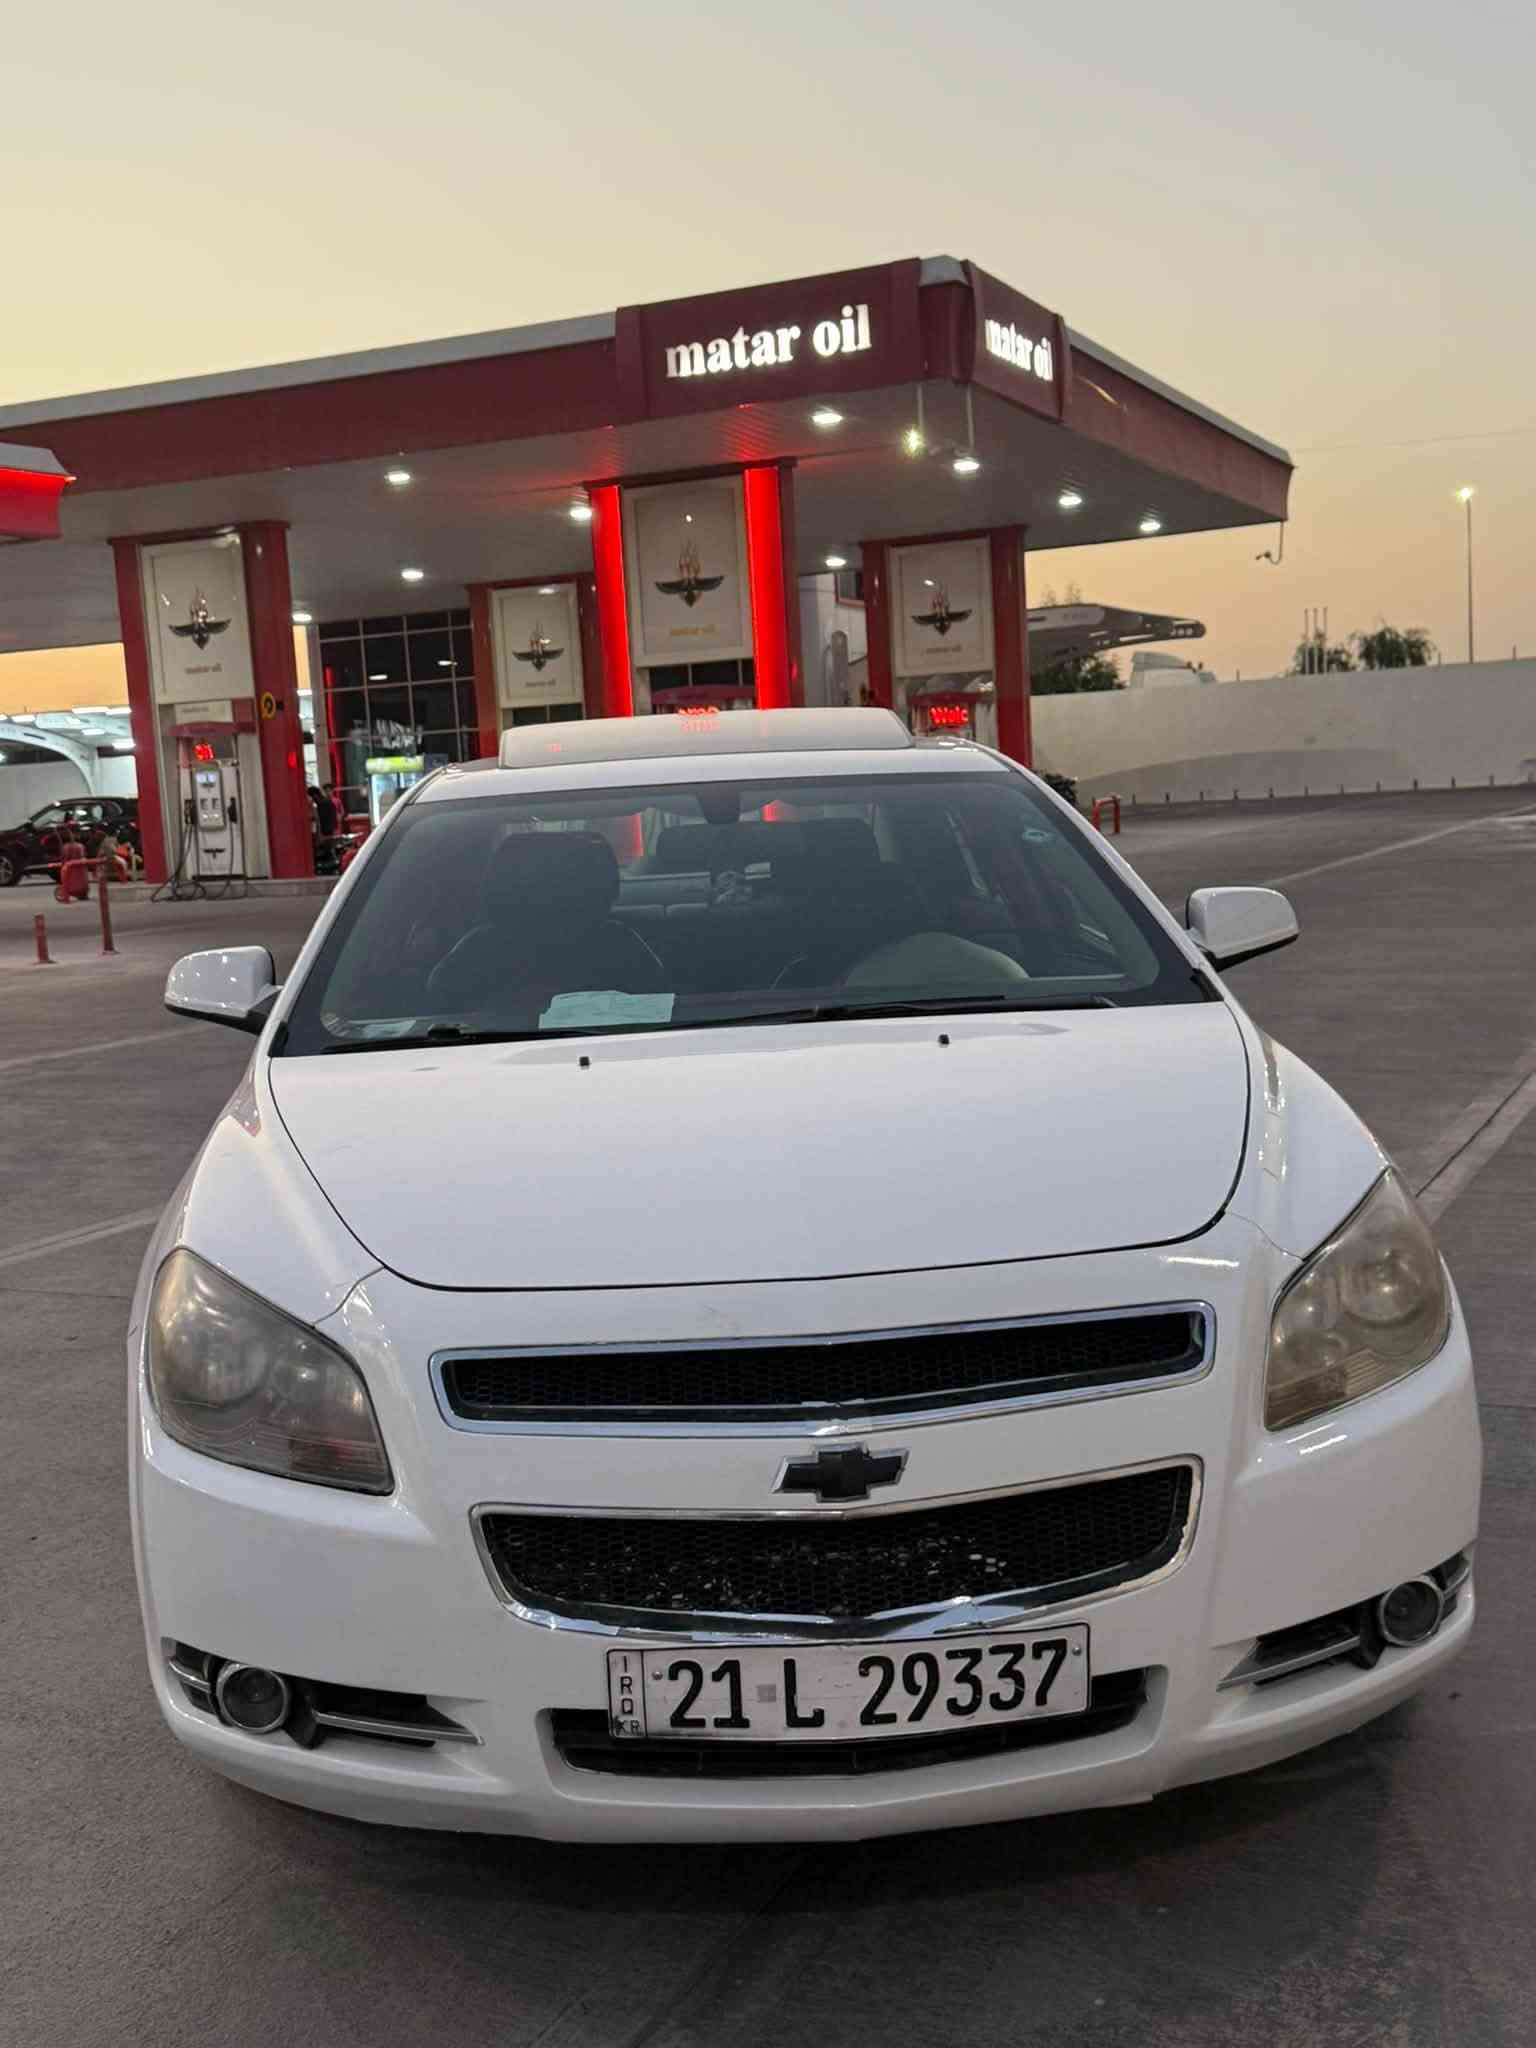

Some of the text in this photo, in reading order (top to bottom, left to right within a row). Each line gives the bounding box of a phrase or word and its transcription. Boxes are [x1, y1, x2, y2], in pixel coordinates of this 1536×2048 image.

[665, 304, 872, 378] matar oil
[984, 319, 1053, 381] matar oil
[668, 1639, 1068, 1729] 21 L 29337
